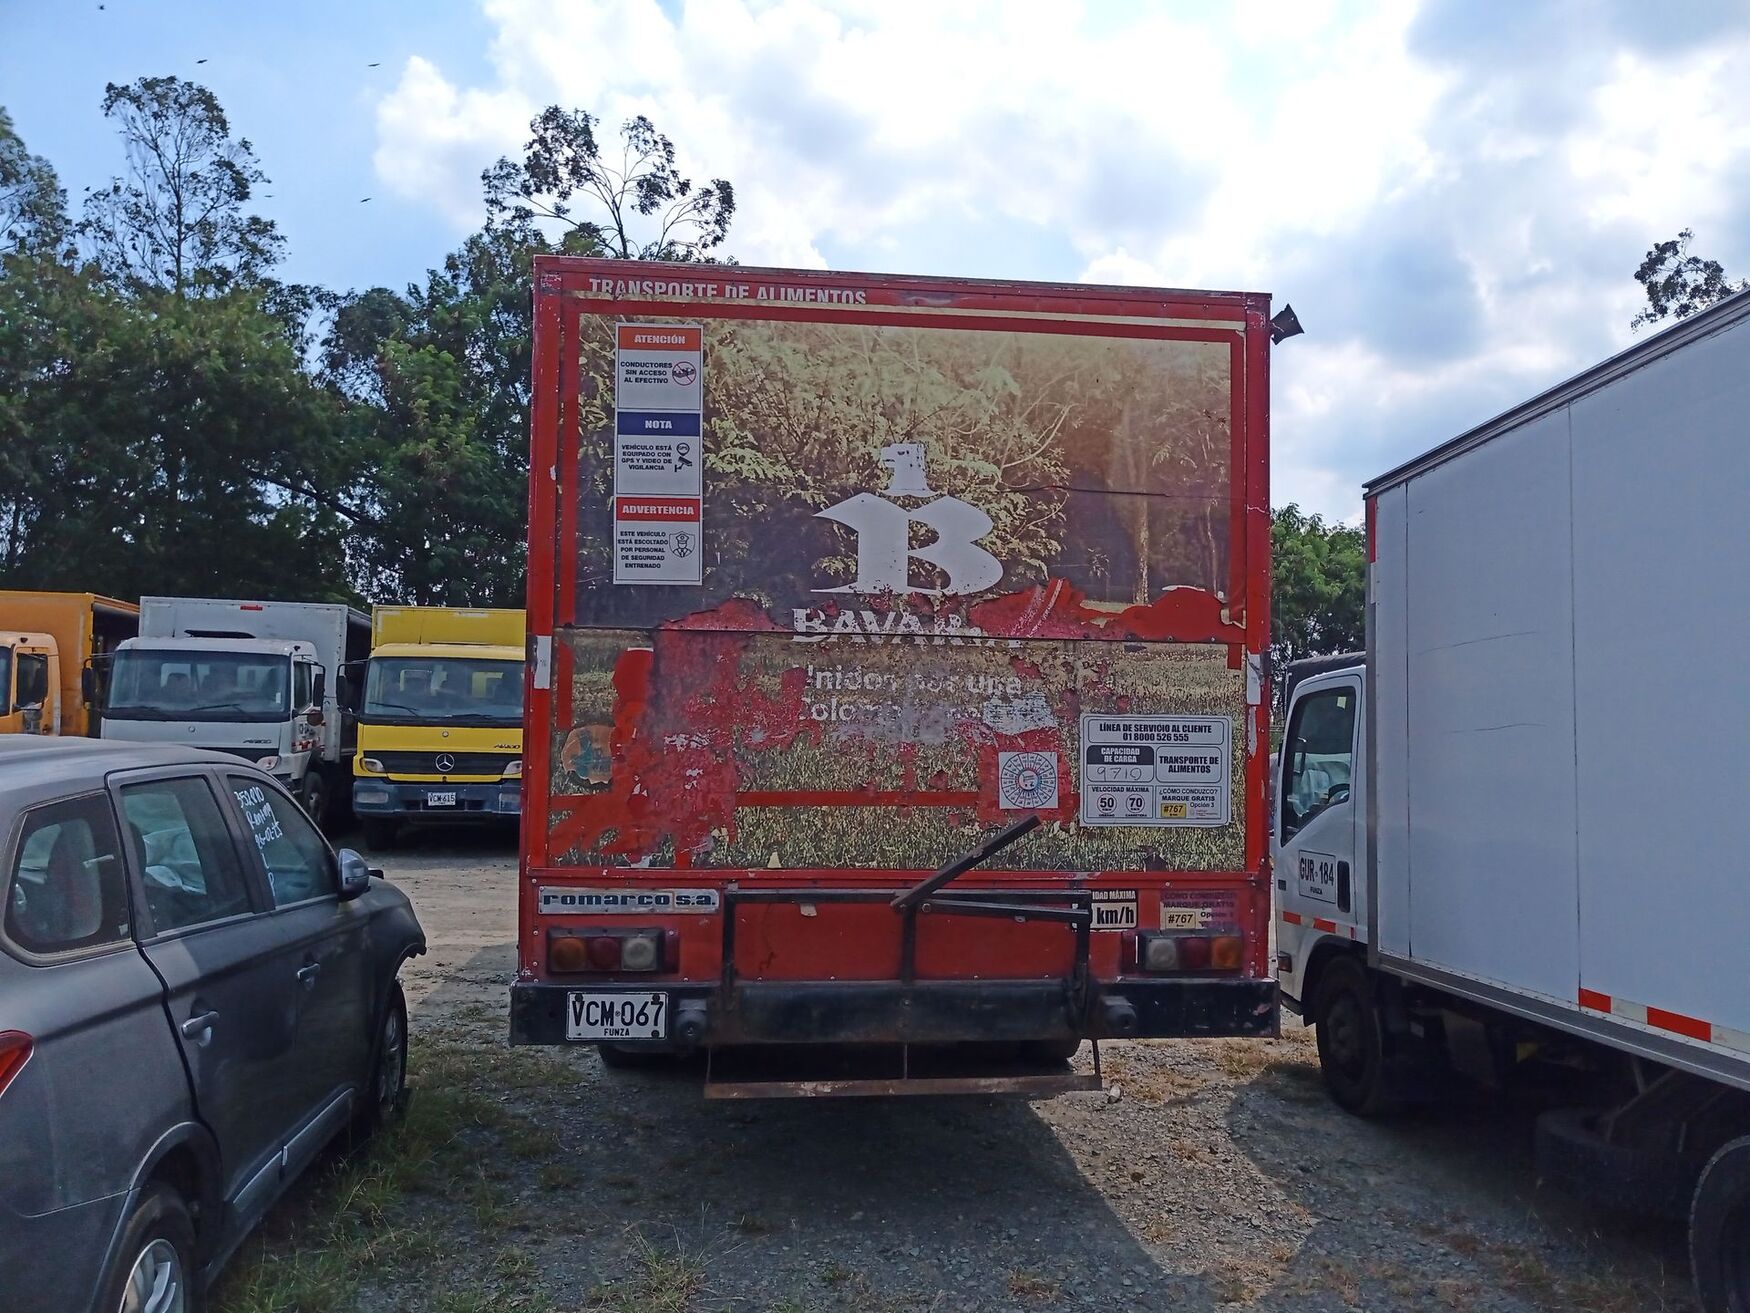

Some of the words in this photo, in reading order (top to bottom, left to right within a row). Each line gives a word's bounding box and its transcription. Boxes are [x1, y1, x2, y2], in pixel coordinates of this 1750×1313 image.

[589, 278, 718, 298] TRANSPORTE
[757, 286, 867, 304] ALIMENTOS
[634, 334, 686, 344] ATENCIÓN
[620, 361, 673, 369] CONDUCTORES
[639, 369, 668, 377] ACCESO
[645, 420, 672, 429] NOTA
[622, 505, 694, 515] ADVERTENCIA
[636, 530, 666, 538] VEHÍCULO
[791, 607, 1023, 648] BAVAR
[1100, 723, 1121, 732] LÍNEA
[1123, 723, 1132, 732] DE
[1134, 724, 1170, 732] SERVICIO
[1183, 725, 1212, 733] CLIENTE
[1123, 733, 1132, 741] 01
[1134, 733, 1155, 741] 8000
[1157, 733, 1172, 741] 526
[1159, 756, 1207, 765] TRANSPORTE
[1209, 757, 1219, 765] DE
[1168, 765, 1211, 774] ALIMENTOS
[1159, 787, 1180, 795] ¿CÓMO
[1100, 797, 1114, 808] 50
[1129, 797, 1143, 808] 70
[1164, 805, 1183, 813] #767
[543, 894, 670, 905] romarco
[675, 894, 716, 906] s.a.
[1109, 890, 1136, 900] MÁXIMA
[1096, 906, 1135, 924] km/h
[1168, 913, 1194, 924] #767
[603, 1028, 630, 1036] FUNZA
